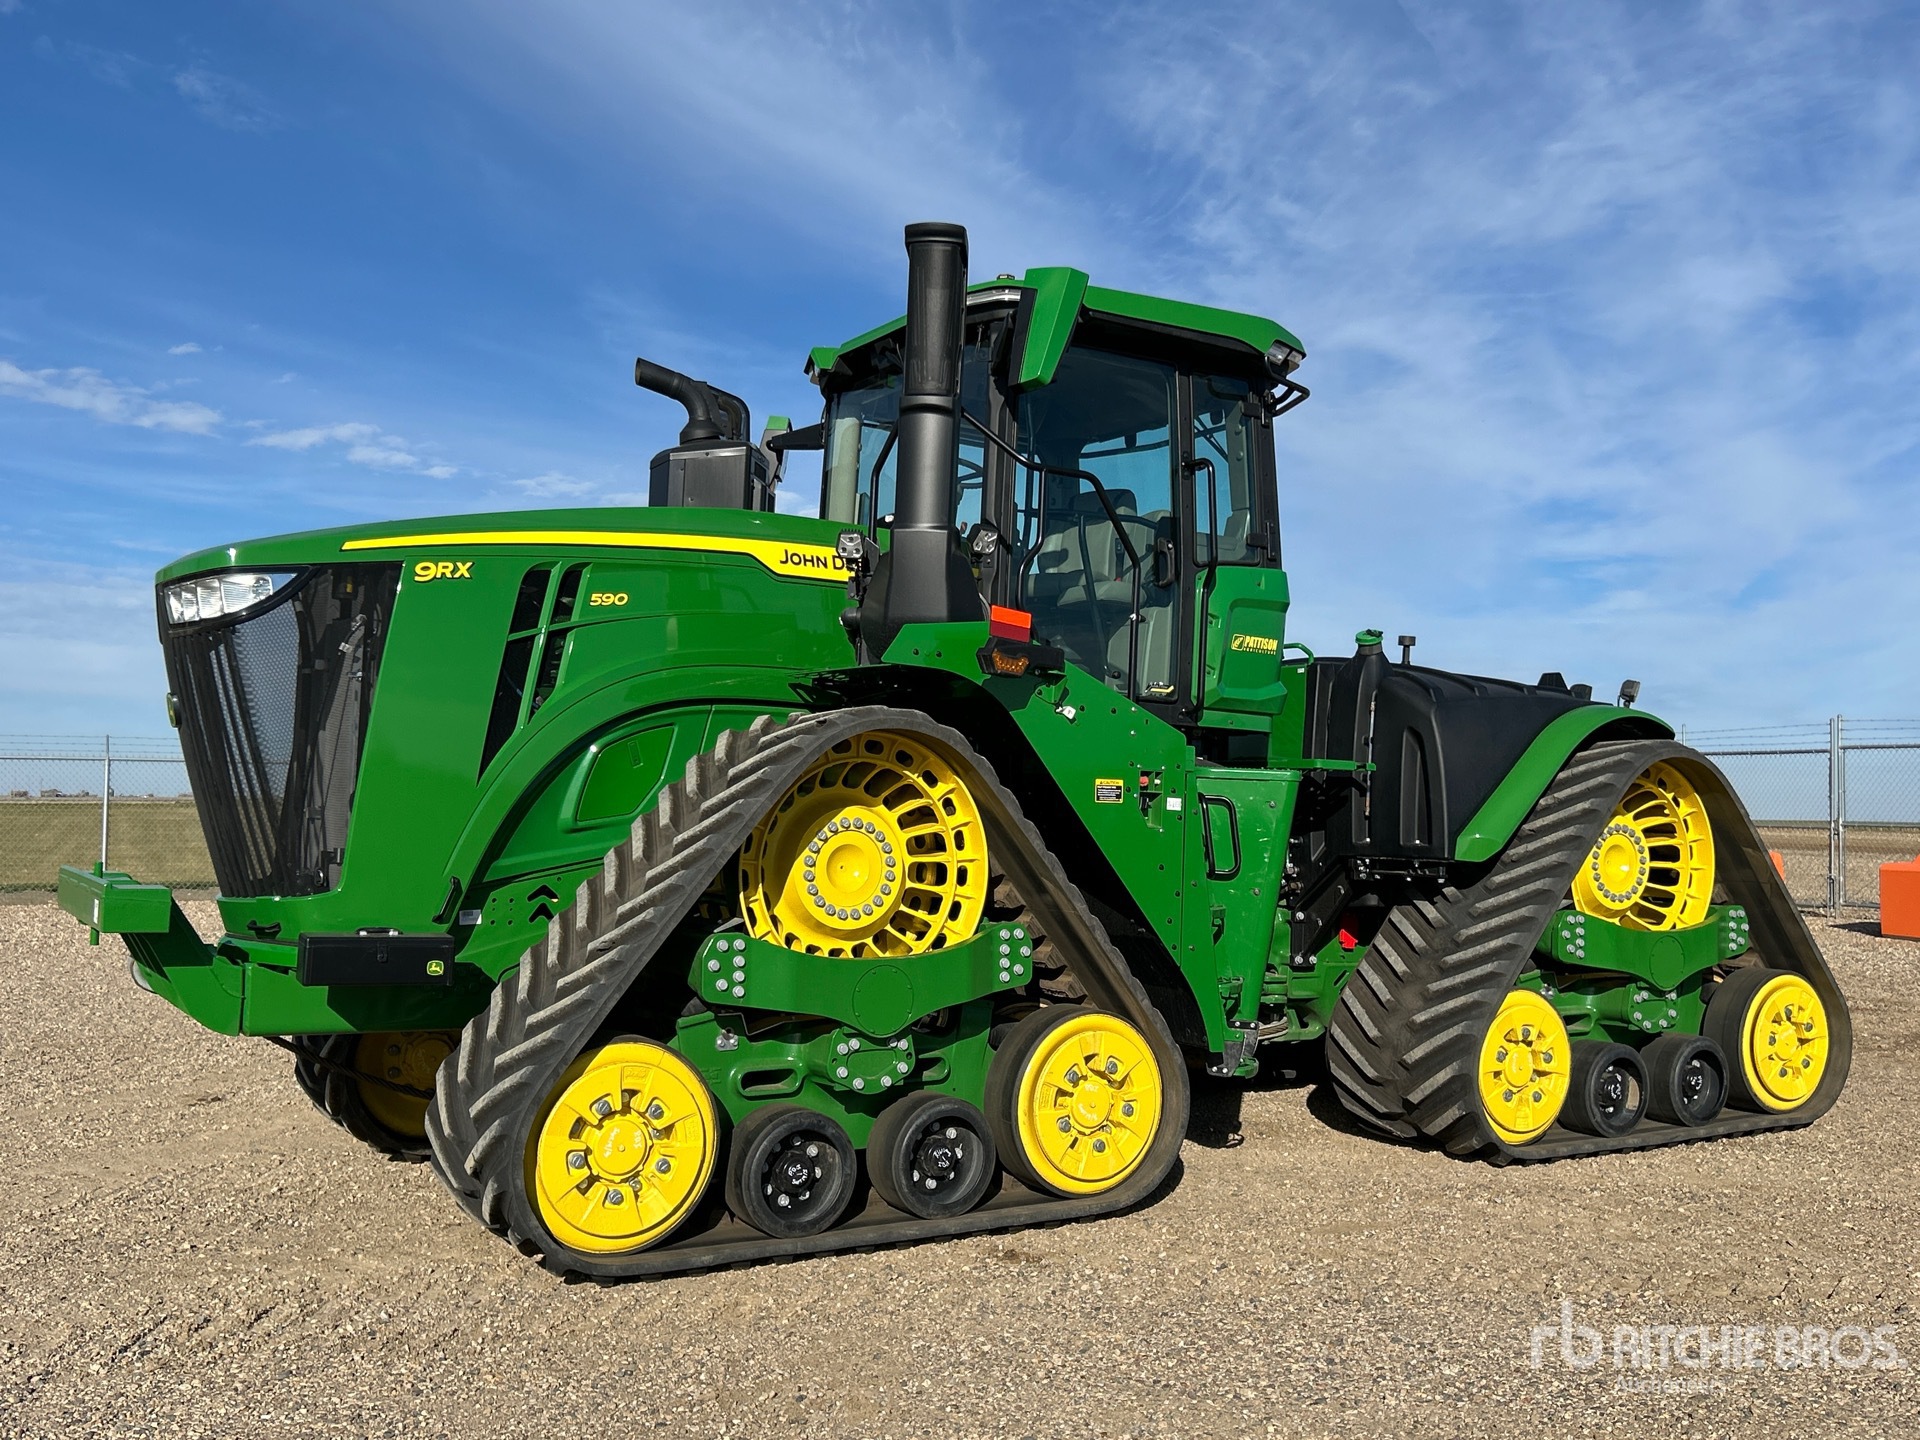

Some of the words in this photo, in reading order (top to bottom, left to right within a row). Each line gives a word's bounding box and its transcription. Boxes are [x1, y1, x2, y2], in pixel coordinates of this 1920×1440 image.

[779, 549, 828, 569] JOHN
[414, 561, 475, 582] 9RX
[589, 593, 629, 606] 590
[1244, 635, 1278, 651] PATTISON
